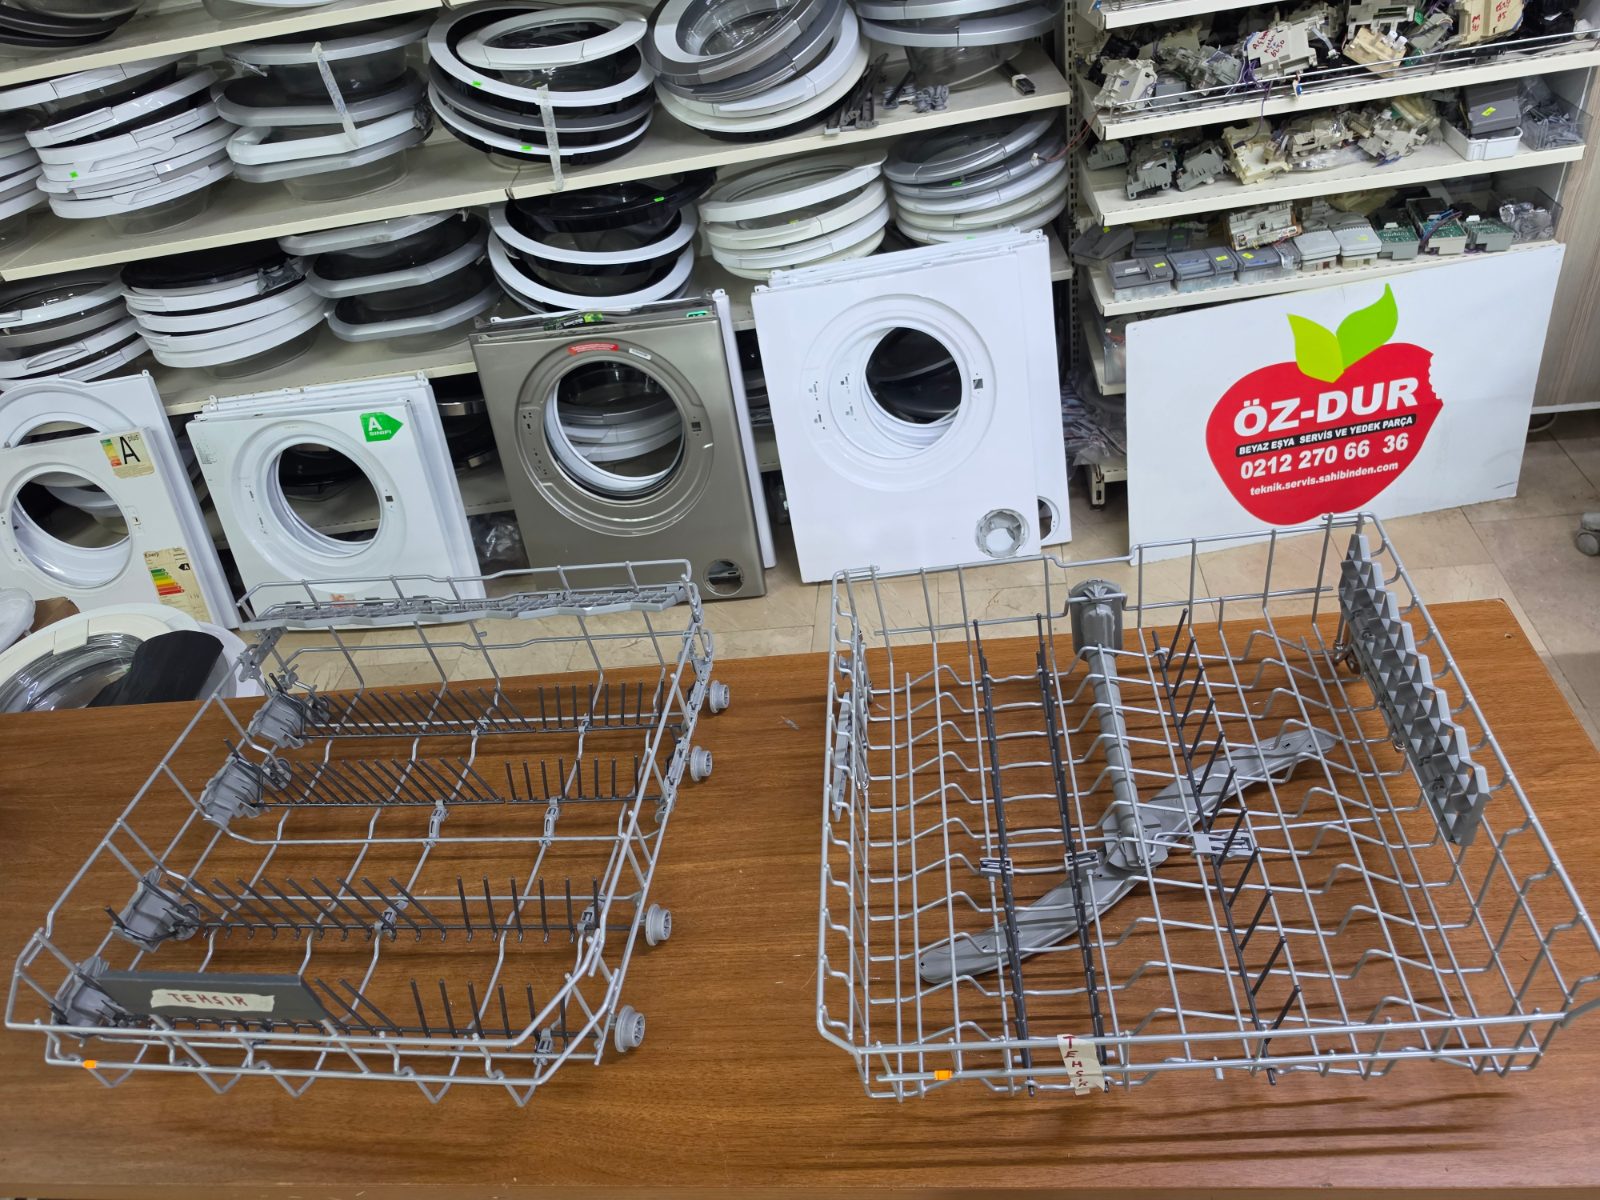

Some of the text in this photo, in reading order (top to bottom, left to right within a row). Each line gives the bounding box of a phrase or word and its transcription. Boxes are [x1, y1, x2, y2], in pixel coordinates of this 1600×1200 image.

[368, 417, 382, 431] A
[1233, 377, 1419, 437] ÖZ-DUR
[120, 436, 141, 465] A
[1239, 416, 1413, 456] BEYAZ EŞYA SERVİS VE YEDEK PARÇA
[1240, 432, 1409, 480] 0212 270 66 36
[1250, 460, 1399, 496] teknik.servis.sahibinden.com
